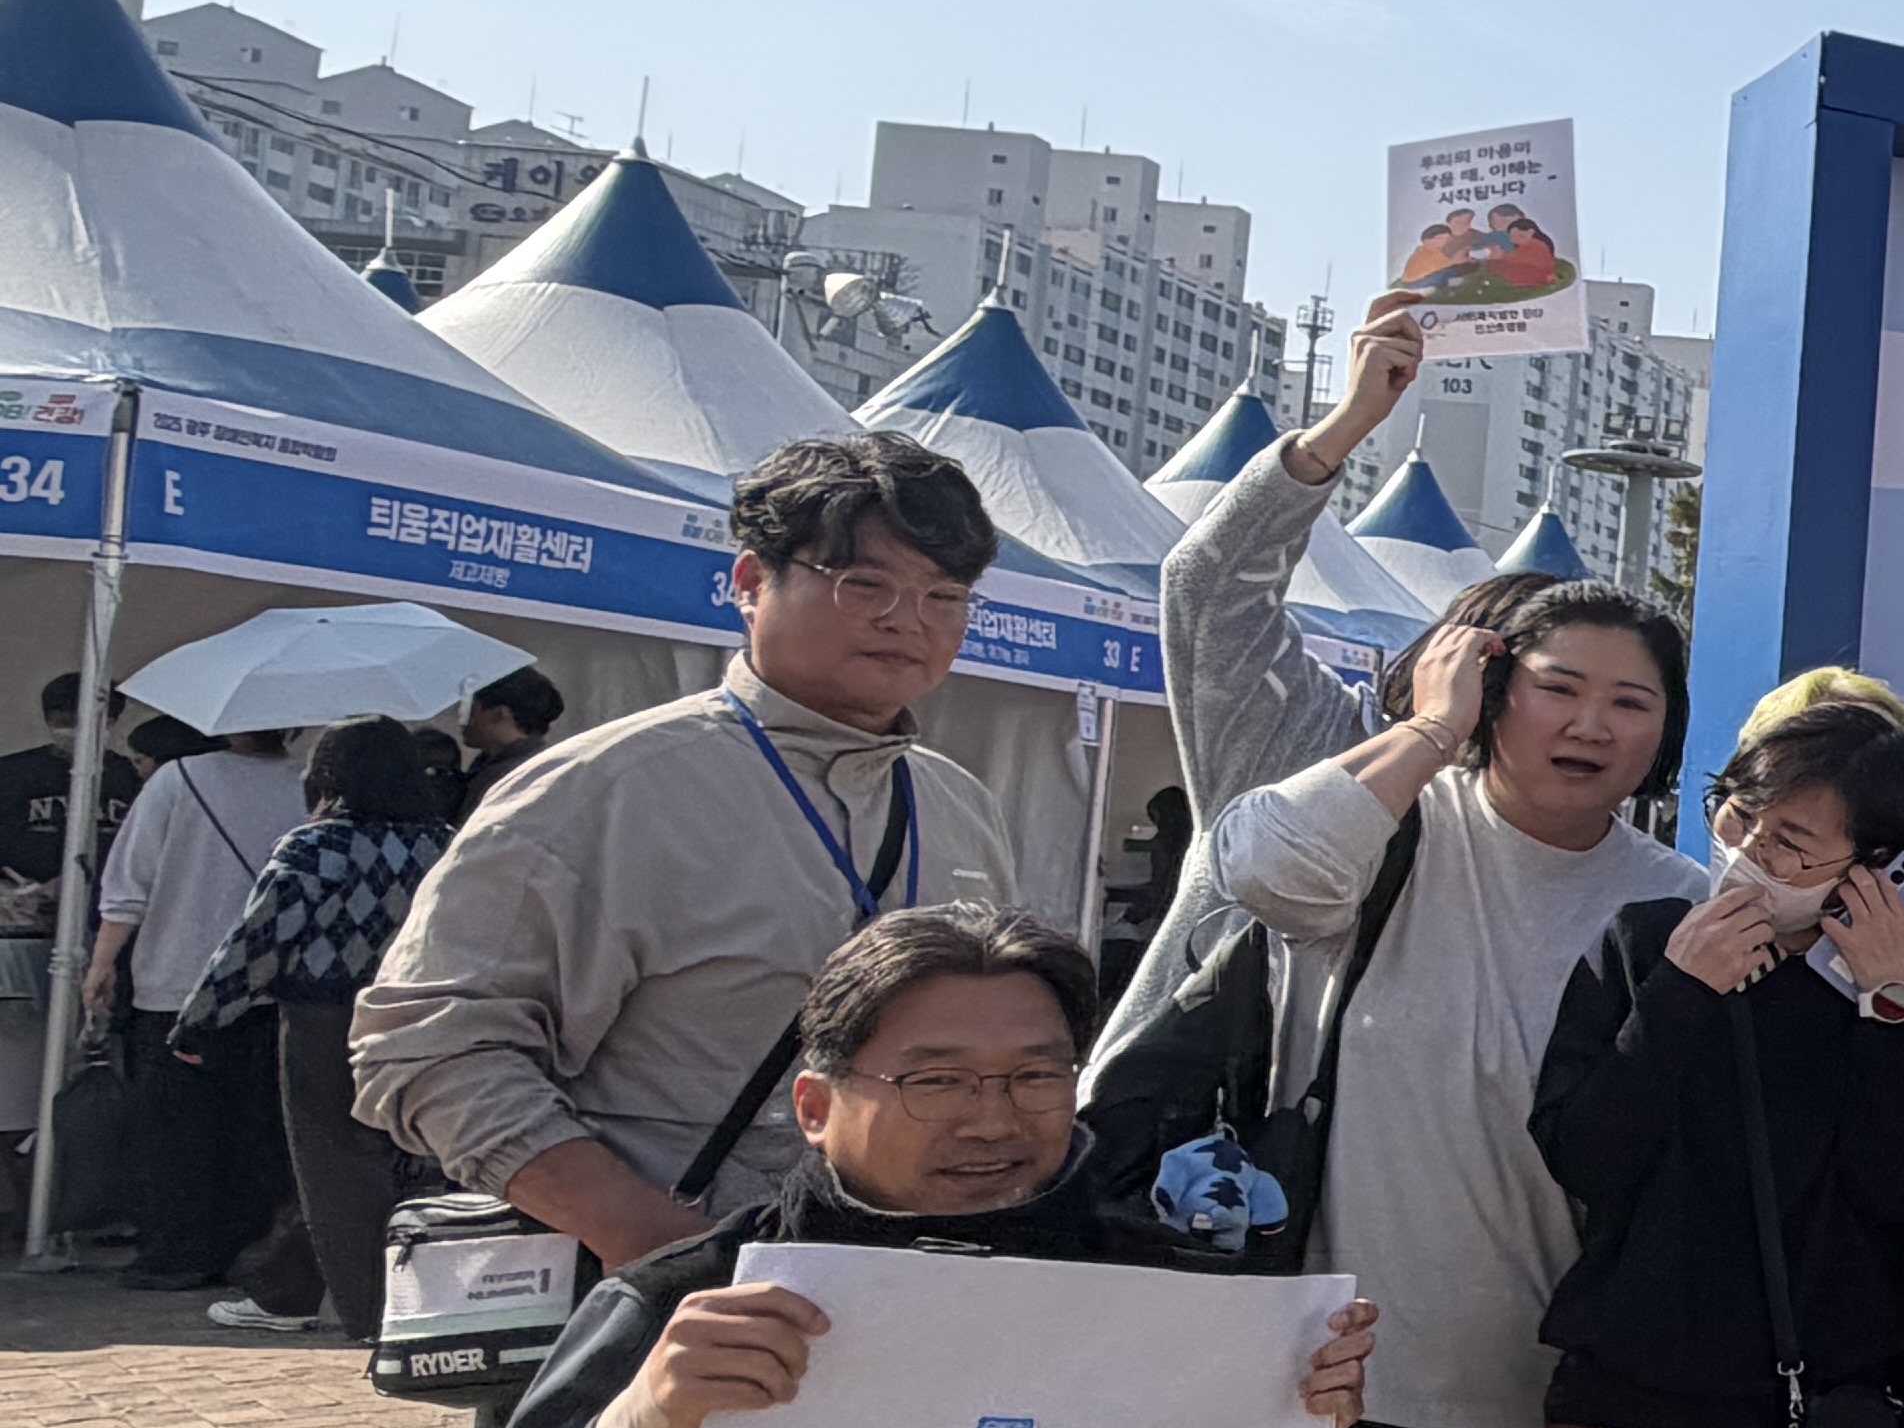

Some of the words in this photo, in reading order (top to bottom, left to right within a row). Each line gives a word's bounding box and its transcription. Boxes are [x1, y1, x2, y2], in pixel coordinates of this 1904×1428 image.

[1441, 378, 1473, 395] 103
[0, 455, 66, 506] 34
[164, 469, 186, 516] E
[366, 496, 595, 575] 틔움직업재활센터
[410, 1348, 488, 1378] RYDER
